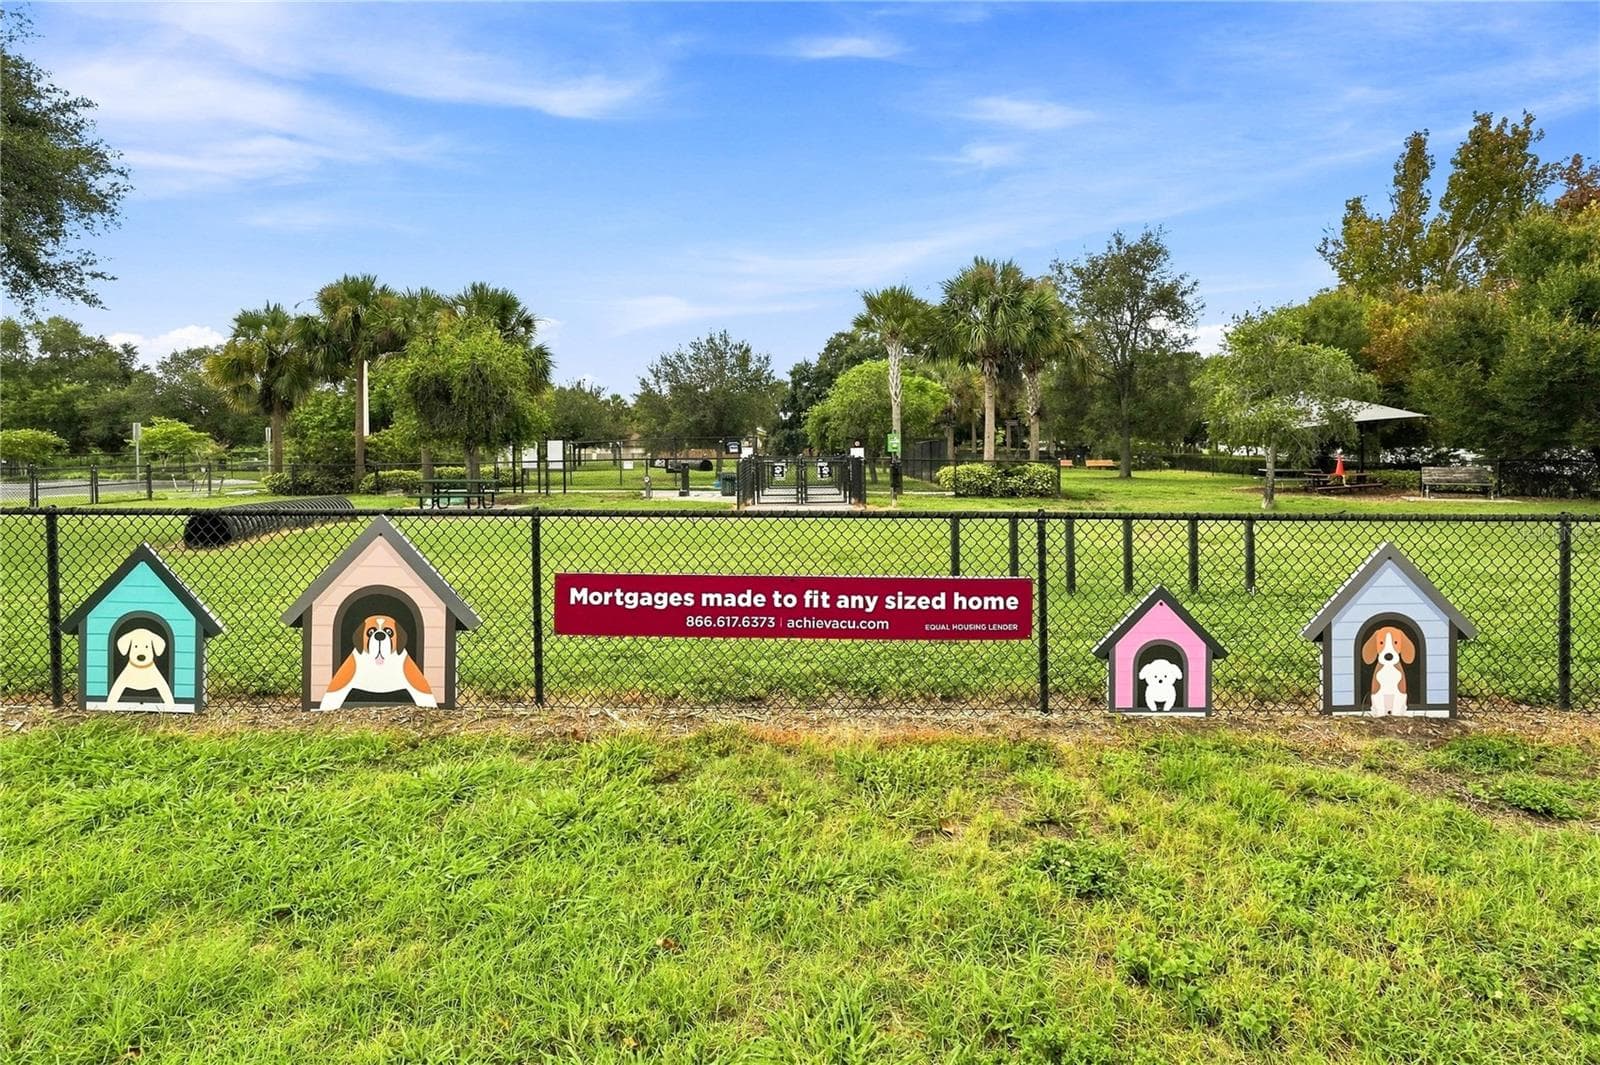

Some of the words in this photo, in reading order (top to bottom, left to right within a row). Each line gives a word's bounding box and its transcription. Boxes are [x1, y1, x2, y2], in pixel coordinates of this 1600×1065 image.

[569, 587, 695, 610] Mortgages
[701, 588, 767, 608] made
[772, 590, 798, 608] to
[803, 588, 831, 609] fit
[836, 594, 879, 613] any
[884, 590, 946, 610] sized
[953, 591, 1019, 610] home
[686, 615, 776, 628] 866.617.6373
[786, 616, 889, 630] achievacu.com
[925, 623, 951, 631] EQUAL
[952, 623, 987, 631] HOUSING
[988, 623, 1018, 631] LENDER
